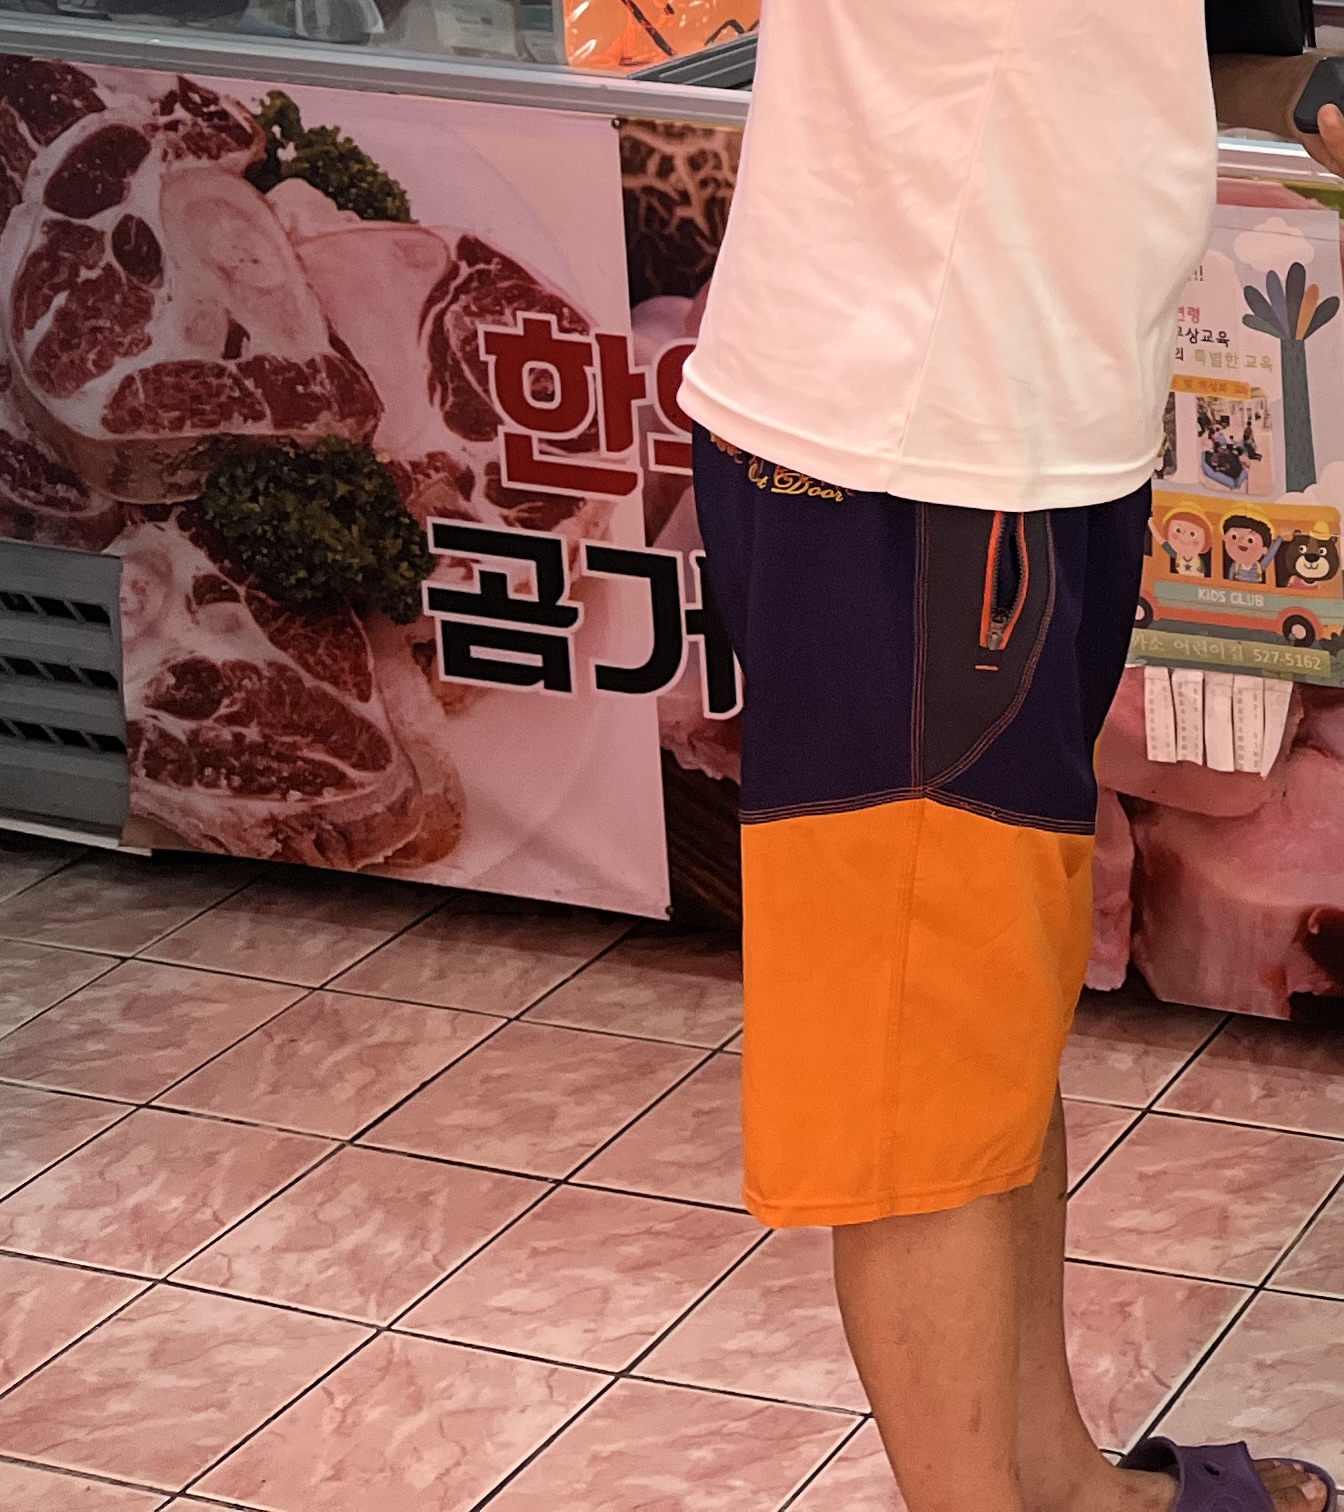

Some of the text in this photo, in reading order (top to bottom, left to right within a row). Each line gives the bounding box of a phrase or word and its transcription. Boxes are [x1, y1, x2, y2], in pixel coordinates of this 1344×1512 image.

[1197, 587, 1265, 608] KIDS CLUB
[1253, 648, 1323, 671] 527-5162
